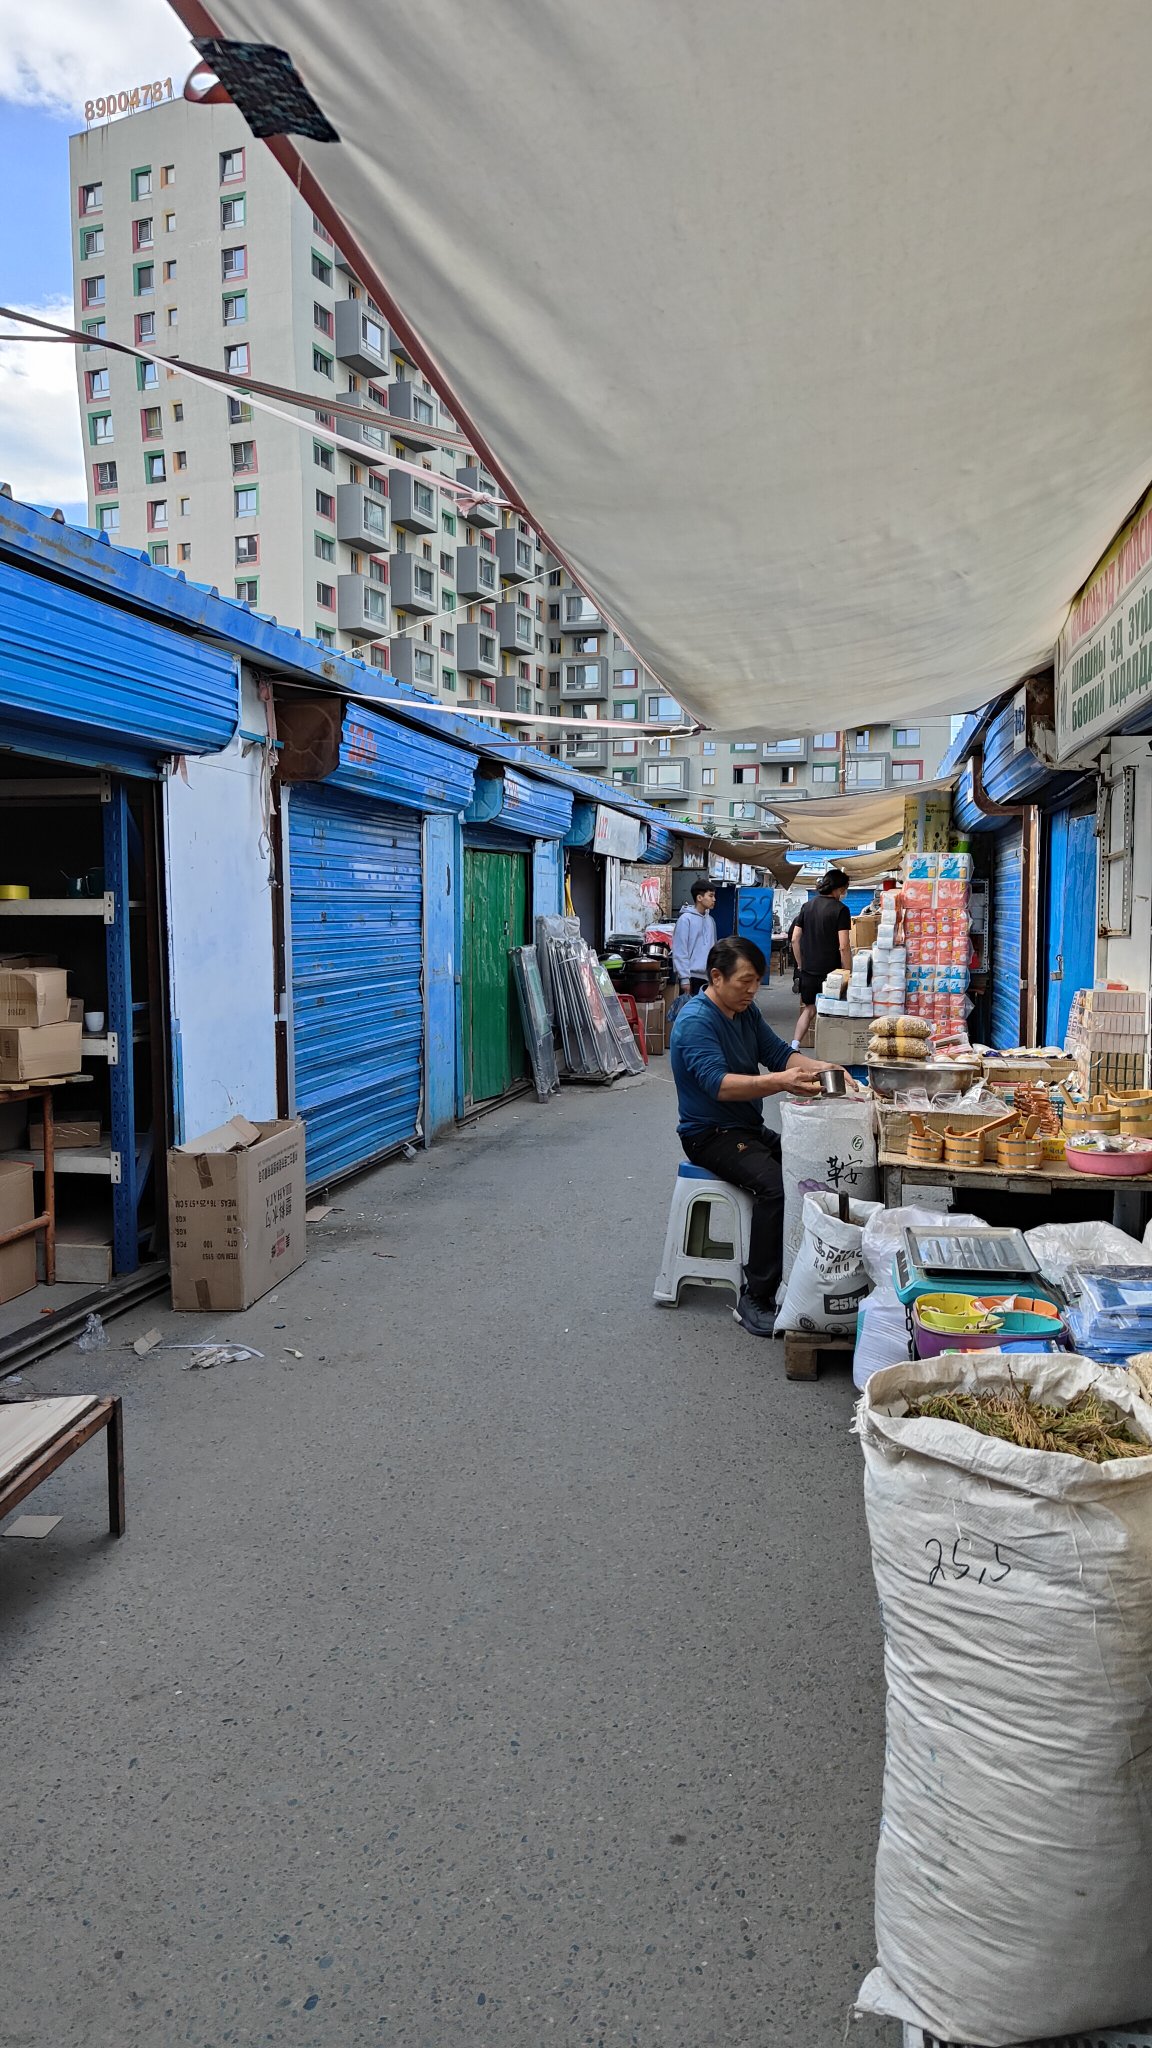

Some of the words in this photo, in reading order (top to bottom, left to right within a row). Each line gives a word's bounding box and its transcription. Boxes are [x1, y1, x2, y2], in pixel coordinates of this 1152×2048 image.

[84, 77, 172, 121] 89004781
[1071, 634, 1106, 695] ШАШНЫ
[1110, 618, 1124, 665] ЭД
[1072, 673, 1105, 732] БӨӨНИЙ
[739, 895, 772, 933] 32
[813, 1256, 850, 1274] Round
[826, 1249, 863, 1264] PALAC
